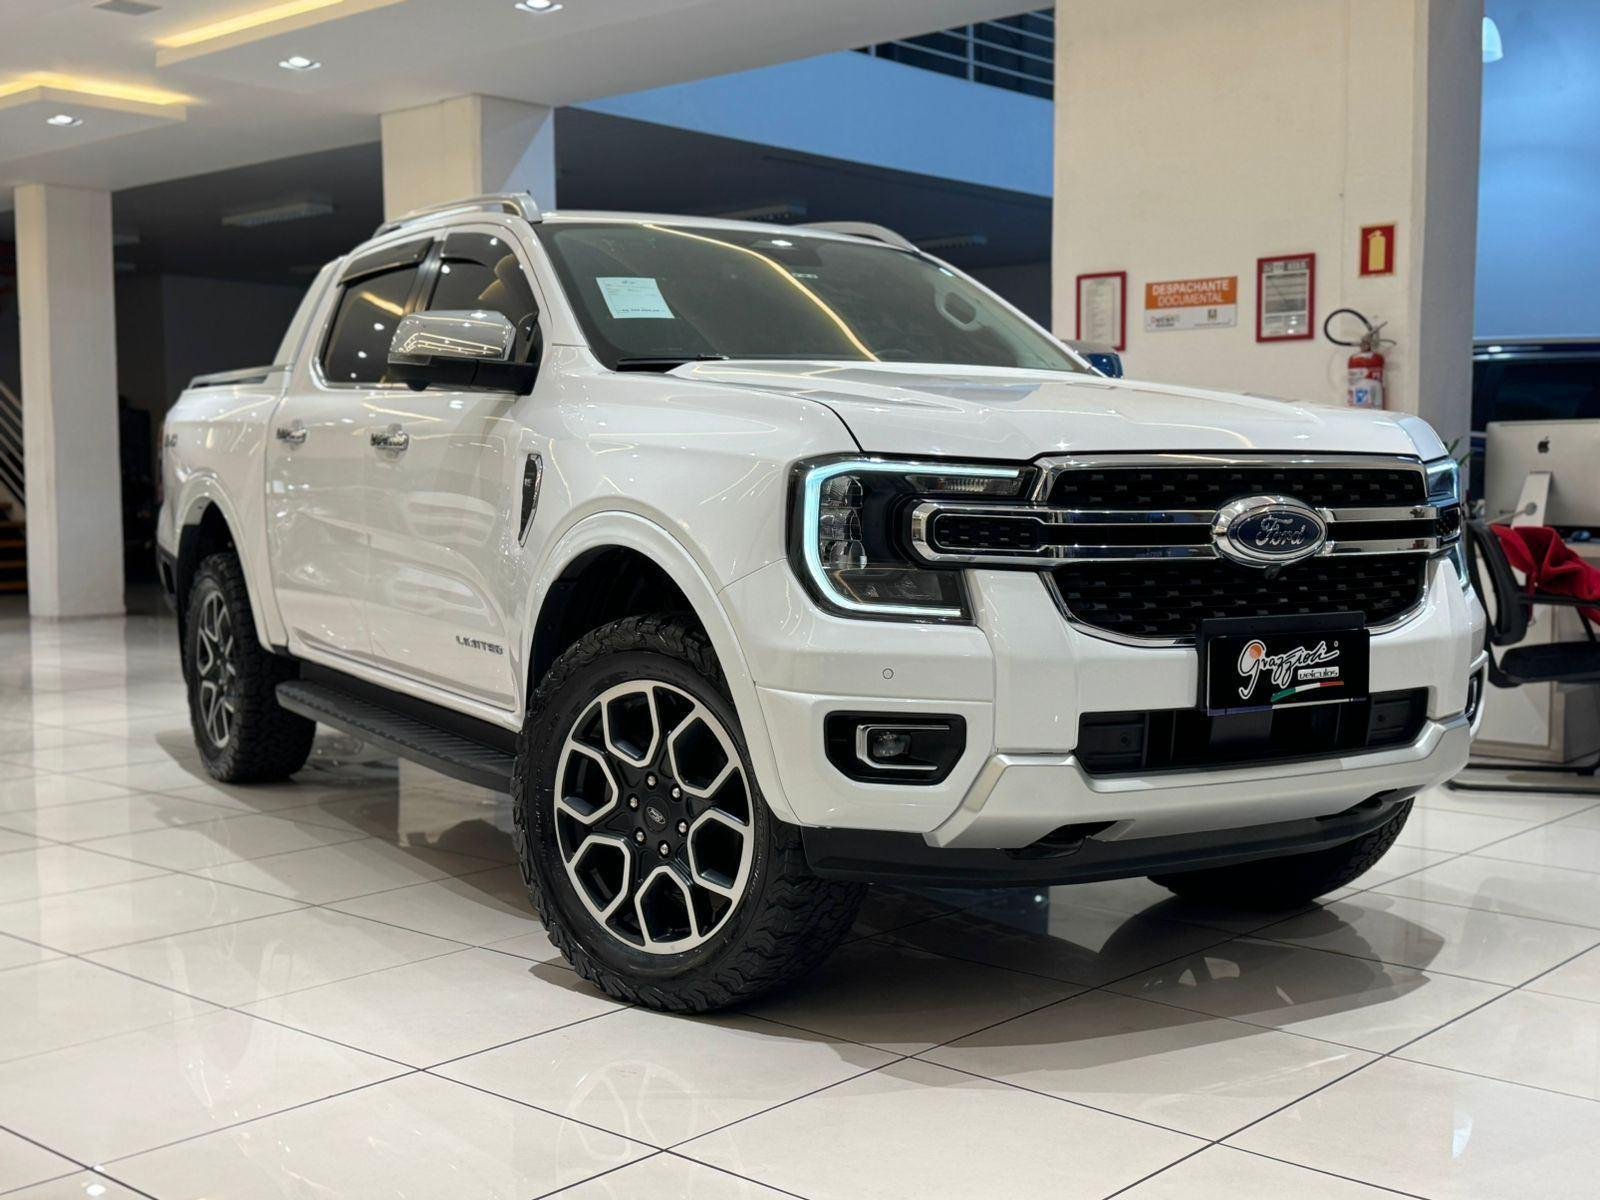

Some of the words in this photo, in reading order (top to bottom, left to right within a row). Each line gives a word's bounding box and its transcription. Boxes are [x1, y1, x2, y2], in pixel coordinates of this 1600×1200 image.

[1152, 280, 1230, 296] DESPACHANTE
[1158, 293, 1225, 306] DOCUMENTAL
[1255, 515, 1305, 546] Ford
